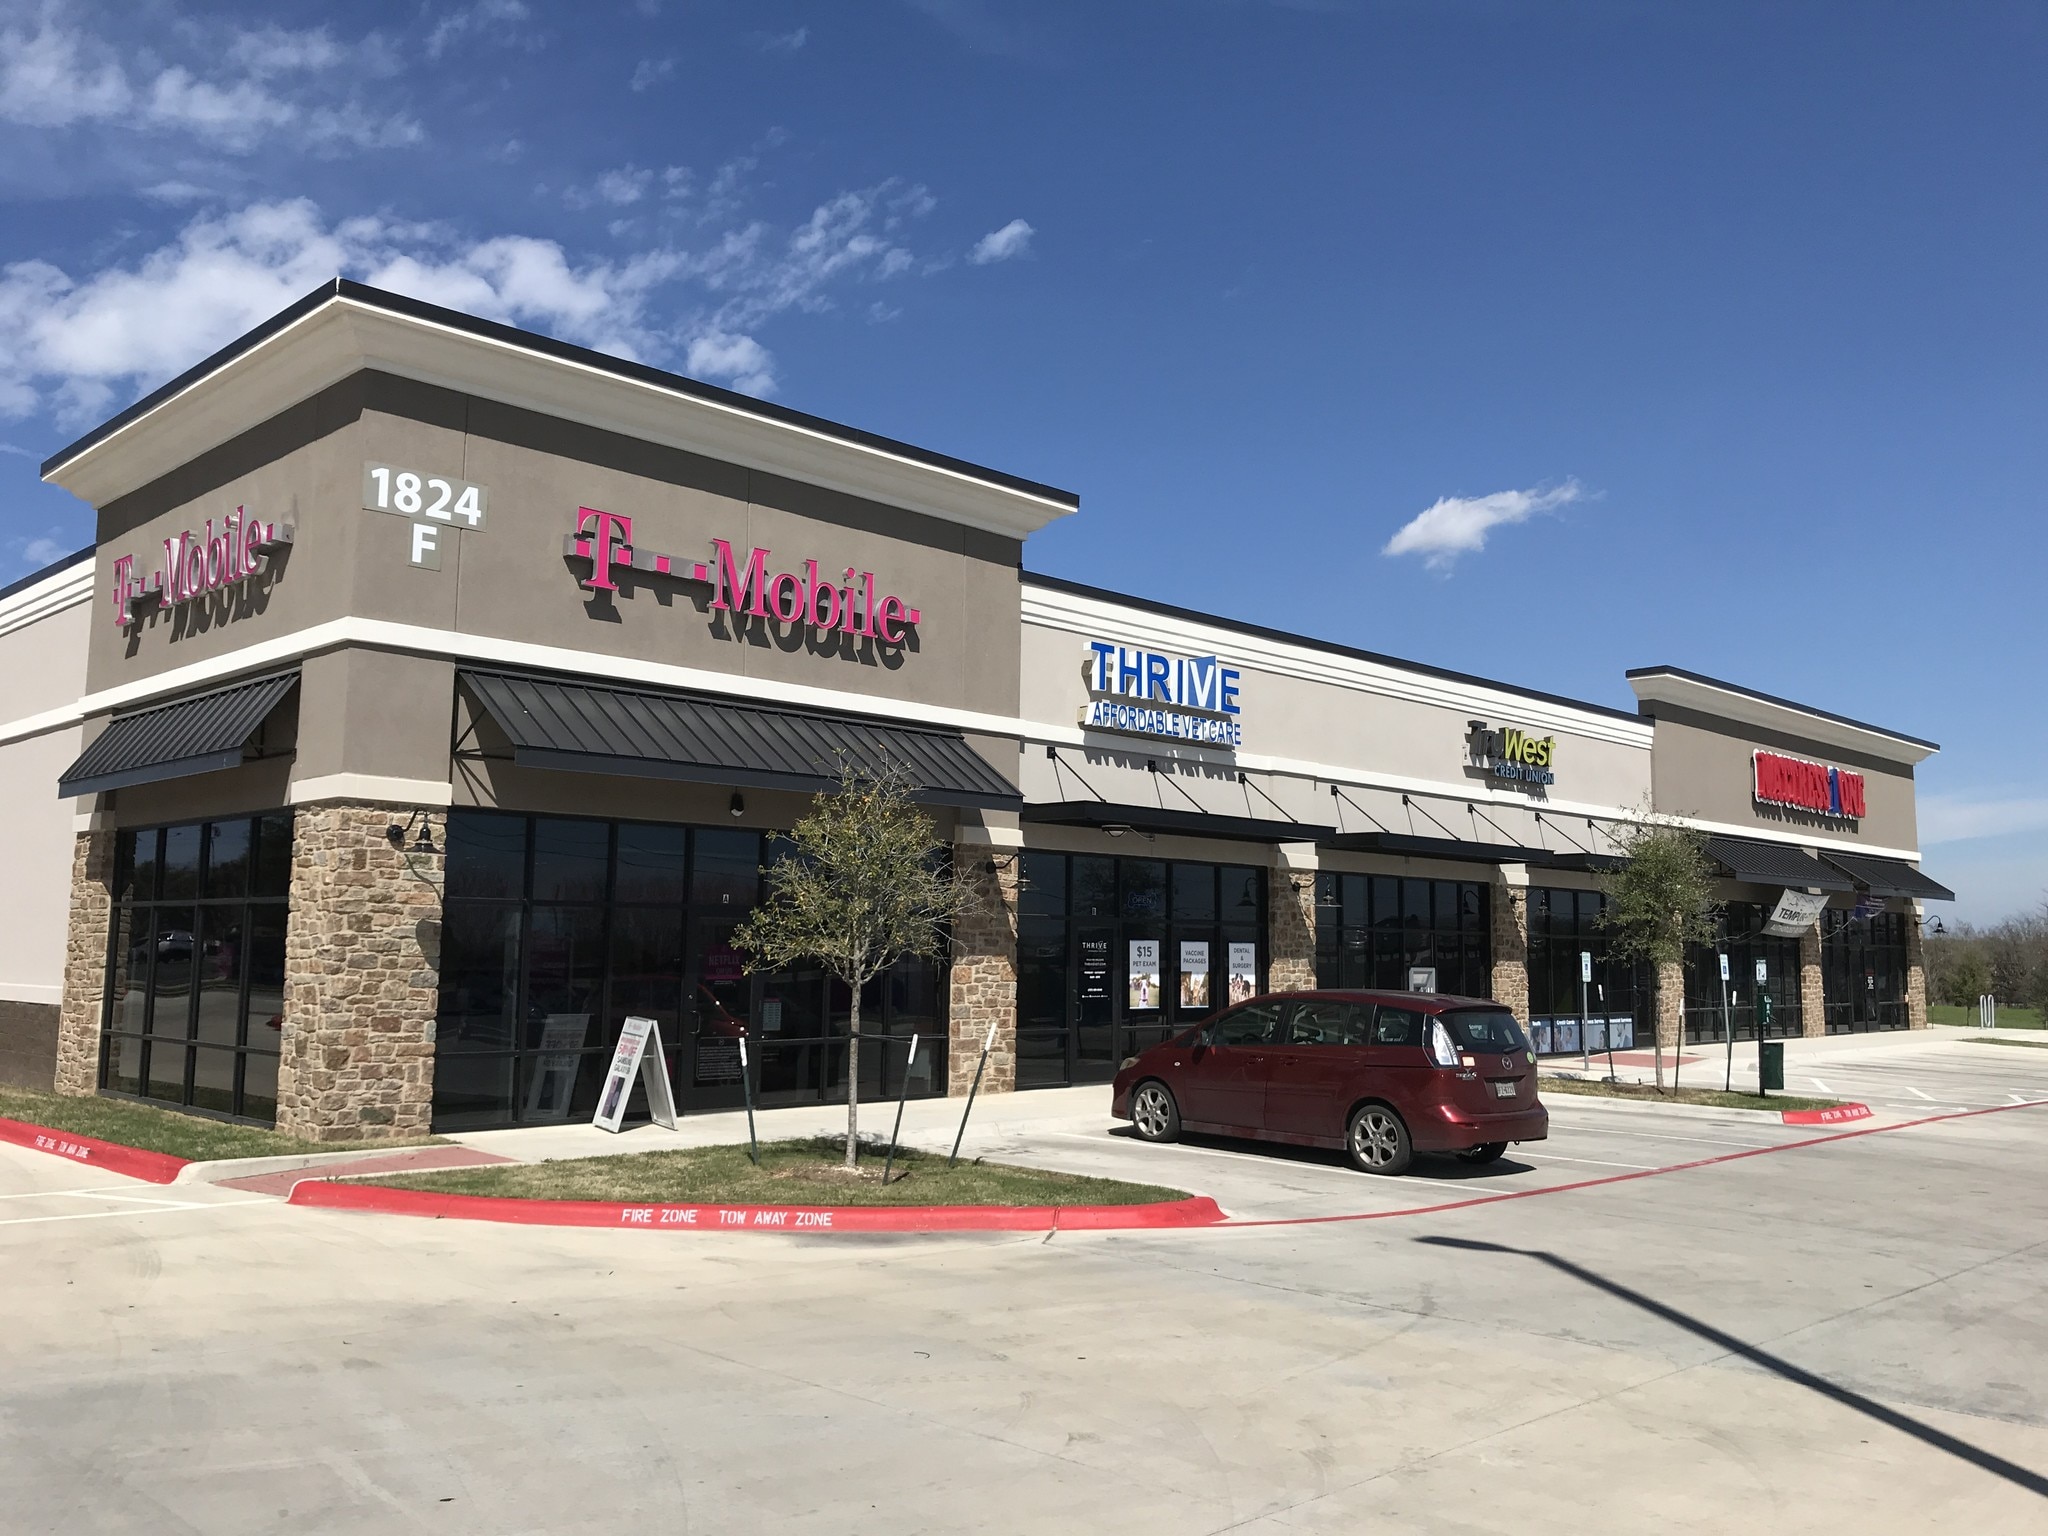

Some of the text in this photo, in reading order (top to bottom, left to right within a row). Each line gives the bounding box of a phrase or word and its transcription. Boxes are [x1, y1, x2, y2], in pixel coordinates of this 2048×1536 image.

[370, 467, 482, 526] 1824
[411, 522, 438, 564] F
[1089, 641, 1241, 715] THRIVE
[1092, 701, 1242, 746] AFFORDABLE VET CARE
[1467, 720, 1557, 768] TruWest
[1494, 764, 1555, 785] CREDIT UNION
[1082, 942, 1107, 950] THRIVE
[1137, 945, 1153, 958] $15
[1233, 947, 1250, 955] DENTAL
[1184, 949, 1205, 957] VACCINE
[708, 954, 741, 967] NETFLIX
[1132, 960, 1157, 968] PET EXAM
[1182, 957, 1207, 965] PACKAGES
[1232, 961, 1252, 970] SURGERY
[621, 1208, 833, 1226] FIRE ZONE TOW AWAY ZONE
